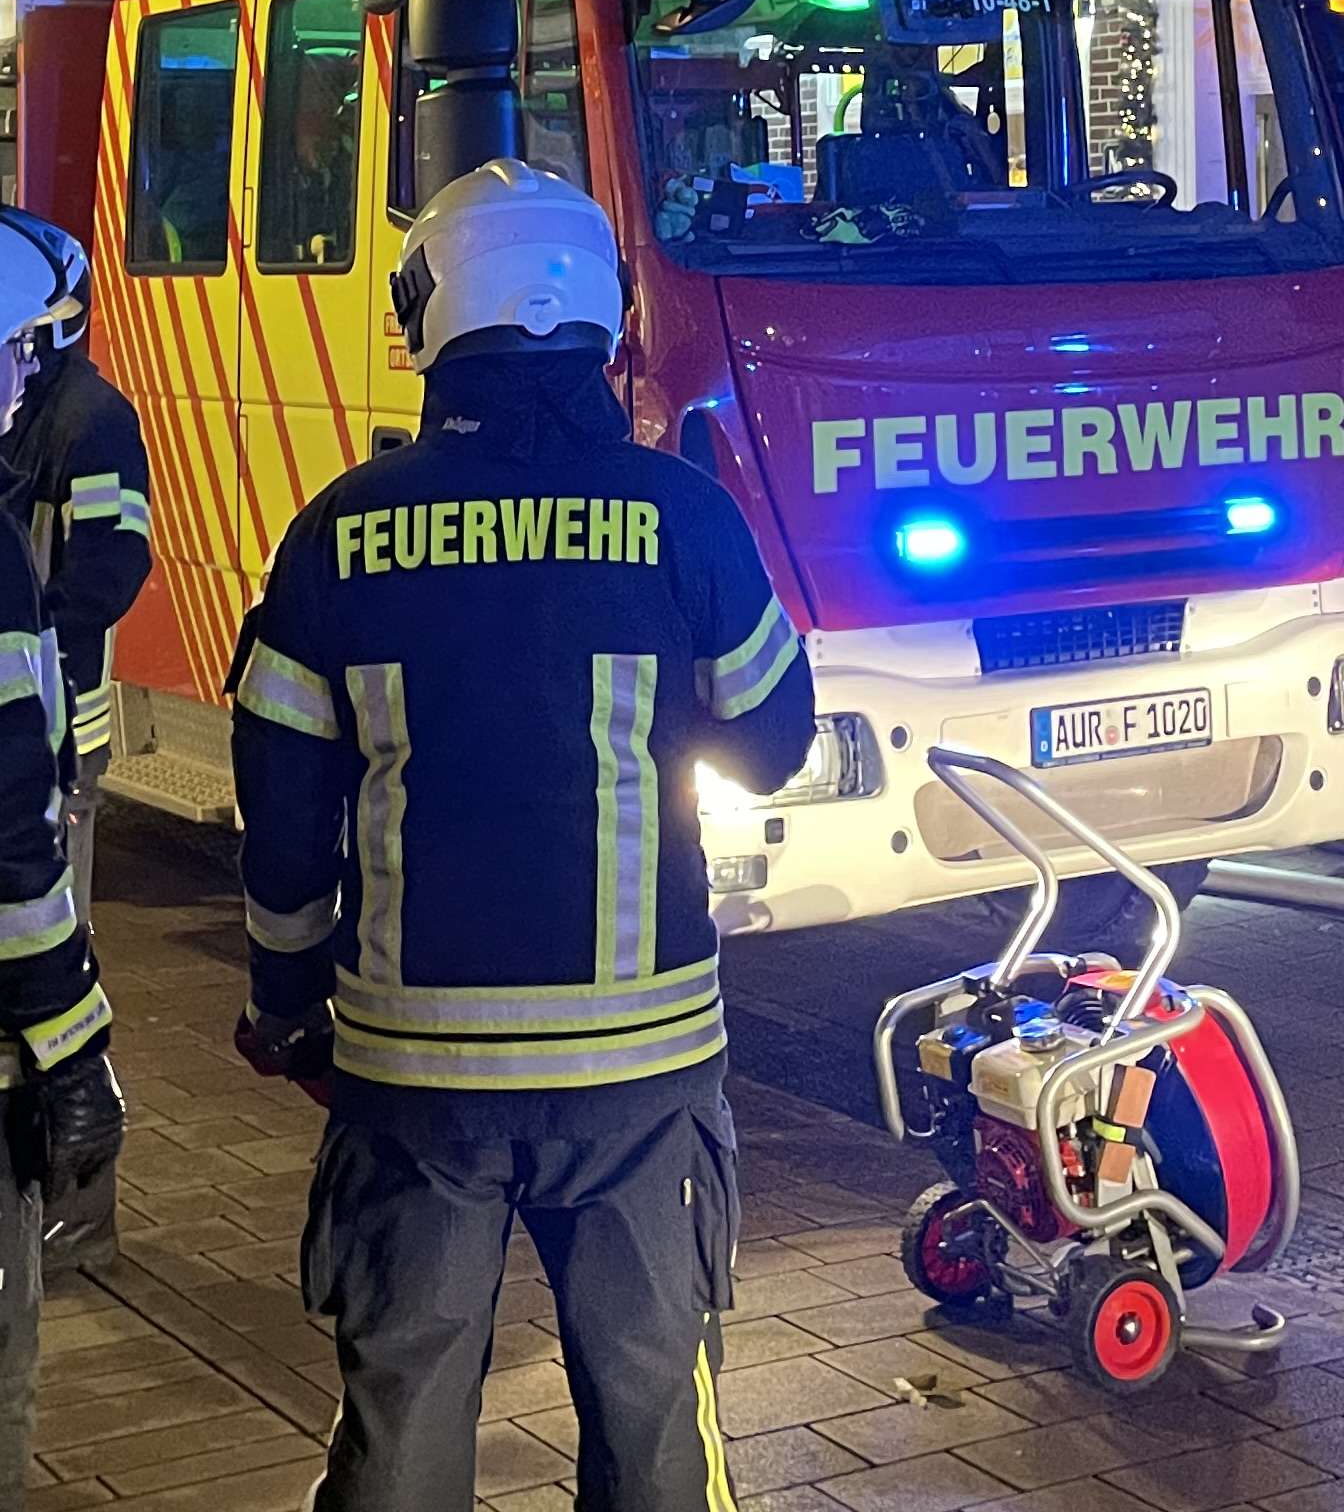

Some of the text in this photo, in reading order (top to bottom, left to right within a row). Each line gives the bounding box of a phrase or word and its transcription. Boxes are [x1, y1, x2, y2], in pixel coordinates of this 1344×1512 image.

[336, 497, 660, 580] FEUERWEHR
[1056, 697, 1208, 752] AUR F 1020
